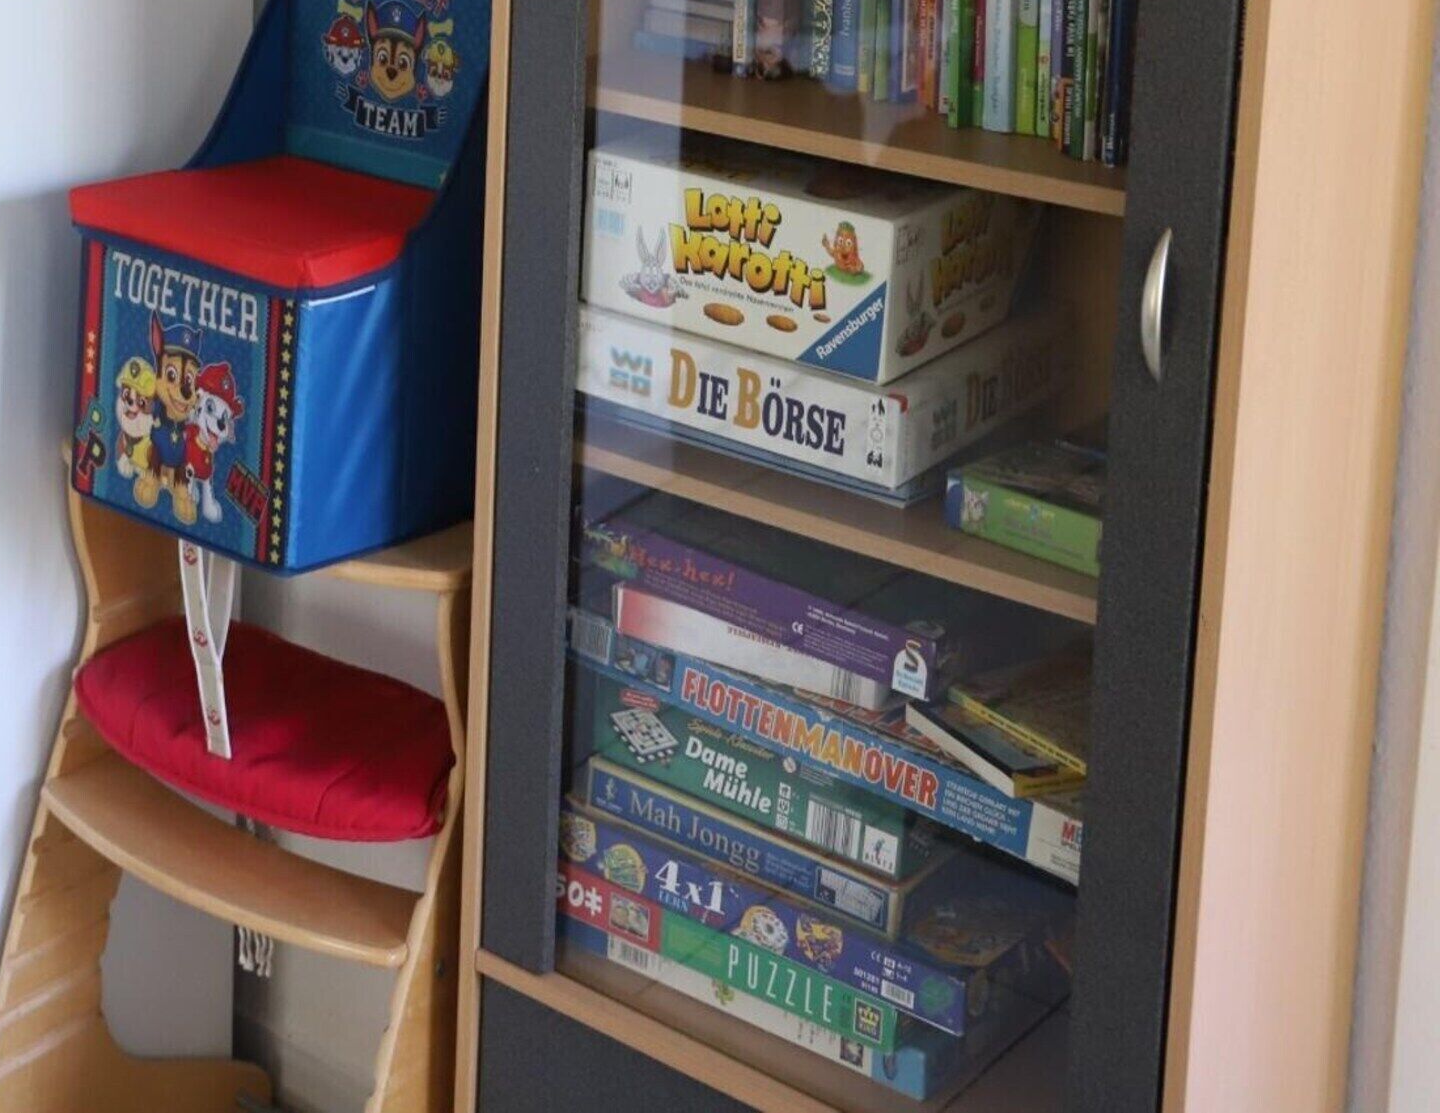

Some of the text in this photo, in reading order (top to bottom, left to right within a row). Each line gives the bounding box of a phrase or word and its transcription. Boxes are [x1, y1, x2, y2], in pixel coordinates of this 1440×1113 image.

[363, 101, 419, 137] TEAM
[683, 188, 782, 249] Lotti
[112, 251, 260, 342] TOGETHER
[668, 222, 827, 311] Karotti
[815, 296, 886, 360] Ravensburger
[667, 347, 729, 421] DIE
[733, 367, 847, 457] BÖRSE
[685, 736, 749, 779] Dame
[703, 768, 772, 814] Mühle
[629, 789, 680, 832] Mah
[686, 813, 761, 875] Jongg
[654, 859, 726, 916] 4x1
[728, 943, 834, 1024] PUZZLE
